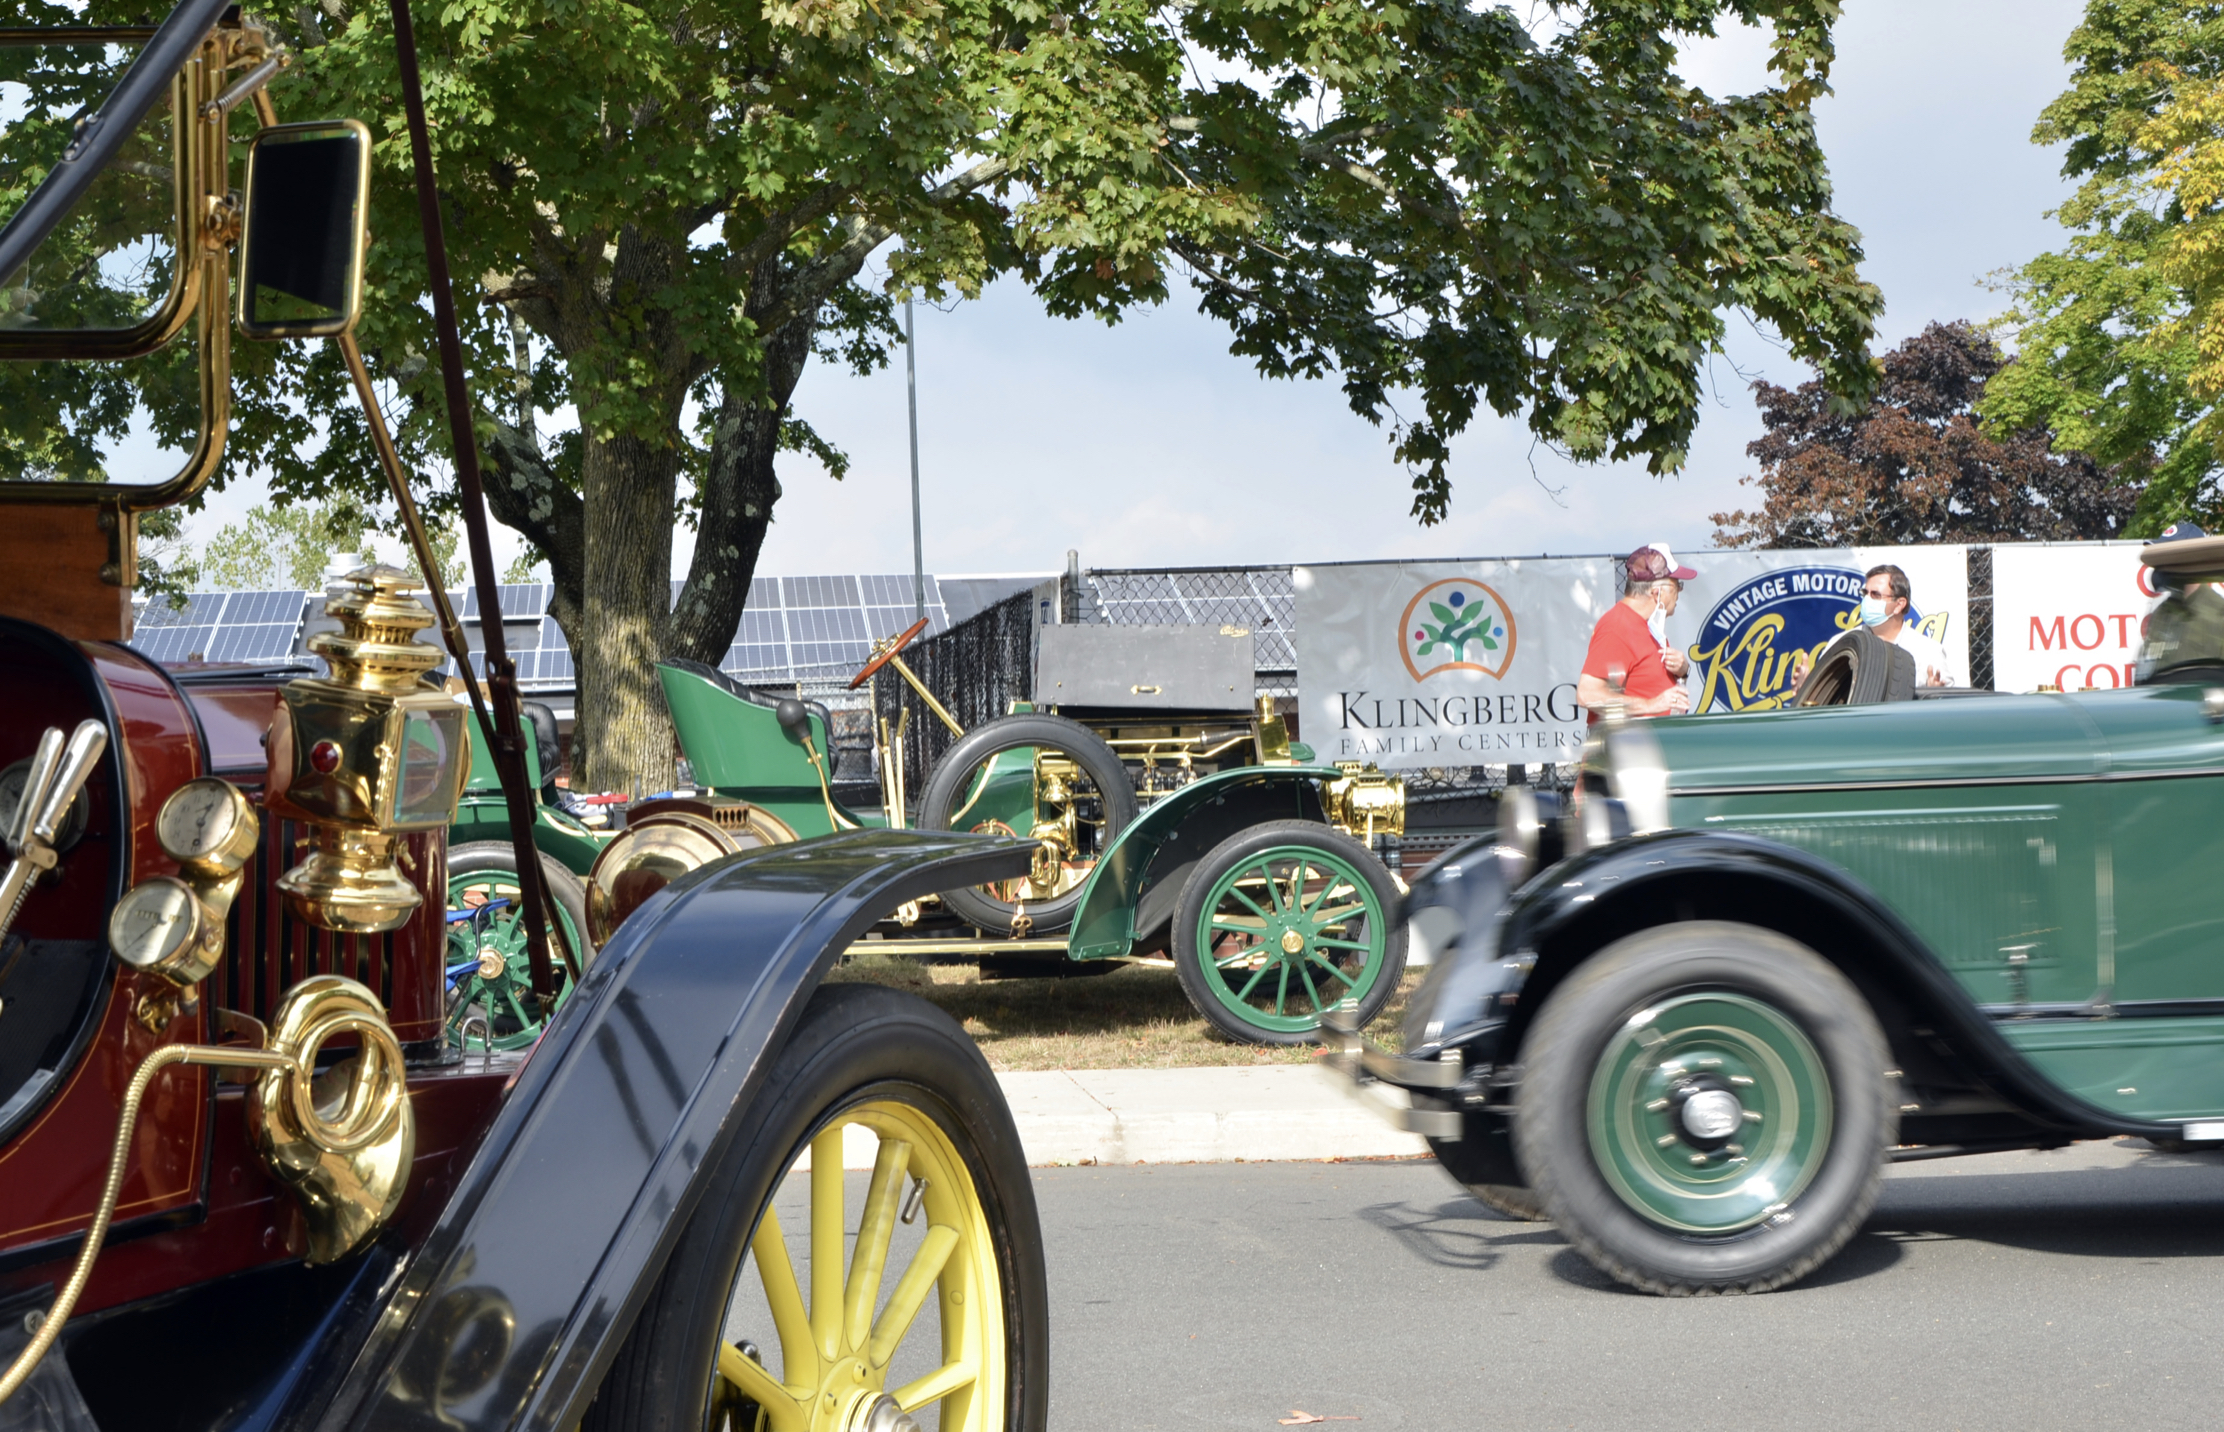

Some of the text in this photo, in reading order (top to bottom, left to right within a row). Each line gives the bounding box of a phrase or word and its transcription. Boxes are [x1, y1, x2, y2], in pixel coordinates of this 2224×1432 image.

[1713, 577, 1788, 631] VINTAGE
[2028, 613, 2152, 651] MOT
[1338, 683, 1579, 730] KLINGBERG
[1340, 729, 1583, 755] FAMILY CENTERS
